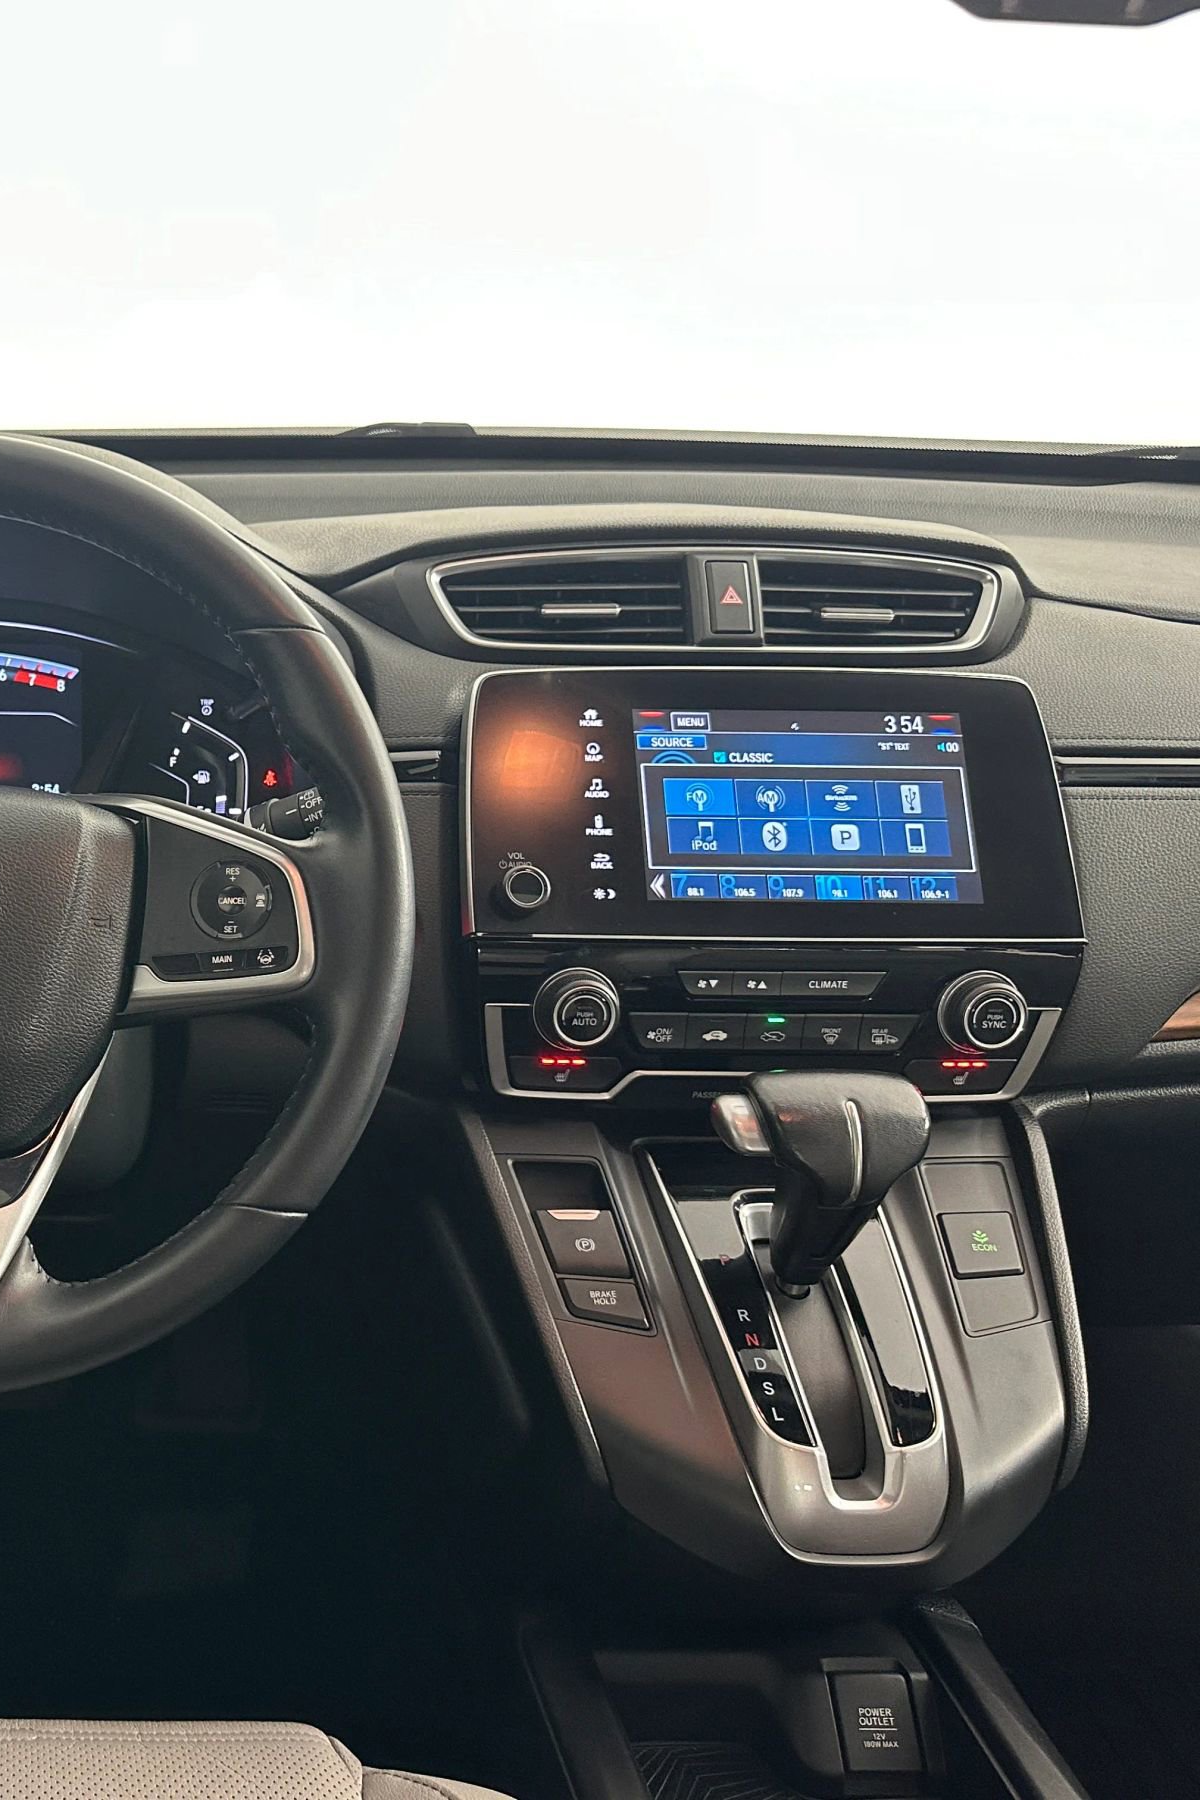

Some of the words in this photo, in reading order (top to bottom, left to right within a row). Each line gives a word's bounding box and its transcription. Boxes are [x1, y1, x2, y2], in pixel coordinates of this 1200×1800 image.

[28, 673, 37, 686] 7
[56, 679, 66, 692] 8
[579, 719, 603, 727] HOME
[677, 717, 704, 727] MENU
[651, 737, 694, 748] SOURCE
[946, 742, 959, 752] 00
[169, 756, 178, 767] F
[584, 754, 604, 762] MAP
[729, 752, 774, 763] CLASSIC
[584, 790, 609, 799] AUDIO
[305, 796, 323, 809] OFF
[308, 809, 323, 822] INT
[586, 828, 613, 836] PHONE
[691, 839, 718, 851] iPod
[507, 851, 525, 860] VOL
[591, 861, 614, 870] BACK
[225, 867, 240, 876] RES
[217, 897, 247, 905] CANCEL
[224, 925, 238, 934] SET
[212, 955, 233, 964] MAIN
[808, 980, 849, 989] CLIMATE
[572, 1018, 597, 1026] AUTO
[982, 1020, 1007, 1029] SYNC
[655, 1035, 673, 1043] OFF
[971, 1243, 998, 1252] ECON
[719, 1254, 730, 1266] P
[590, 1290, 617, 1298] BRAKE
[593, 1297, 617, 1305] HOLD
[737, 1309, 751, 1322] R
[745, 1333, 760, 1347] N
[754, 1357, 767, 1371] D
[762, 1382, 775, 1395] S
[771, 1407, 784, 1421] L
[858, 1707, 892, 1717] POWER
[858, 1717, 895, 1726] OUTLET
[882, 1740, 899, 1748] MAX
